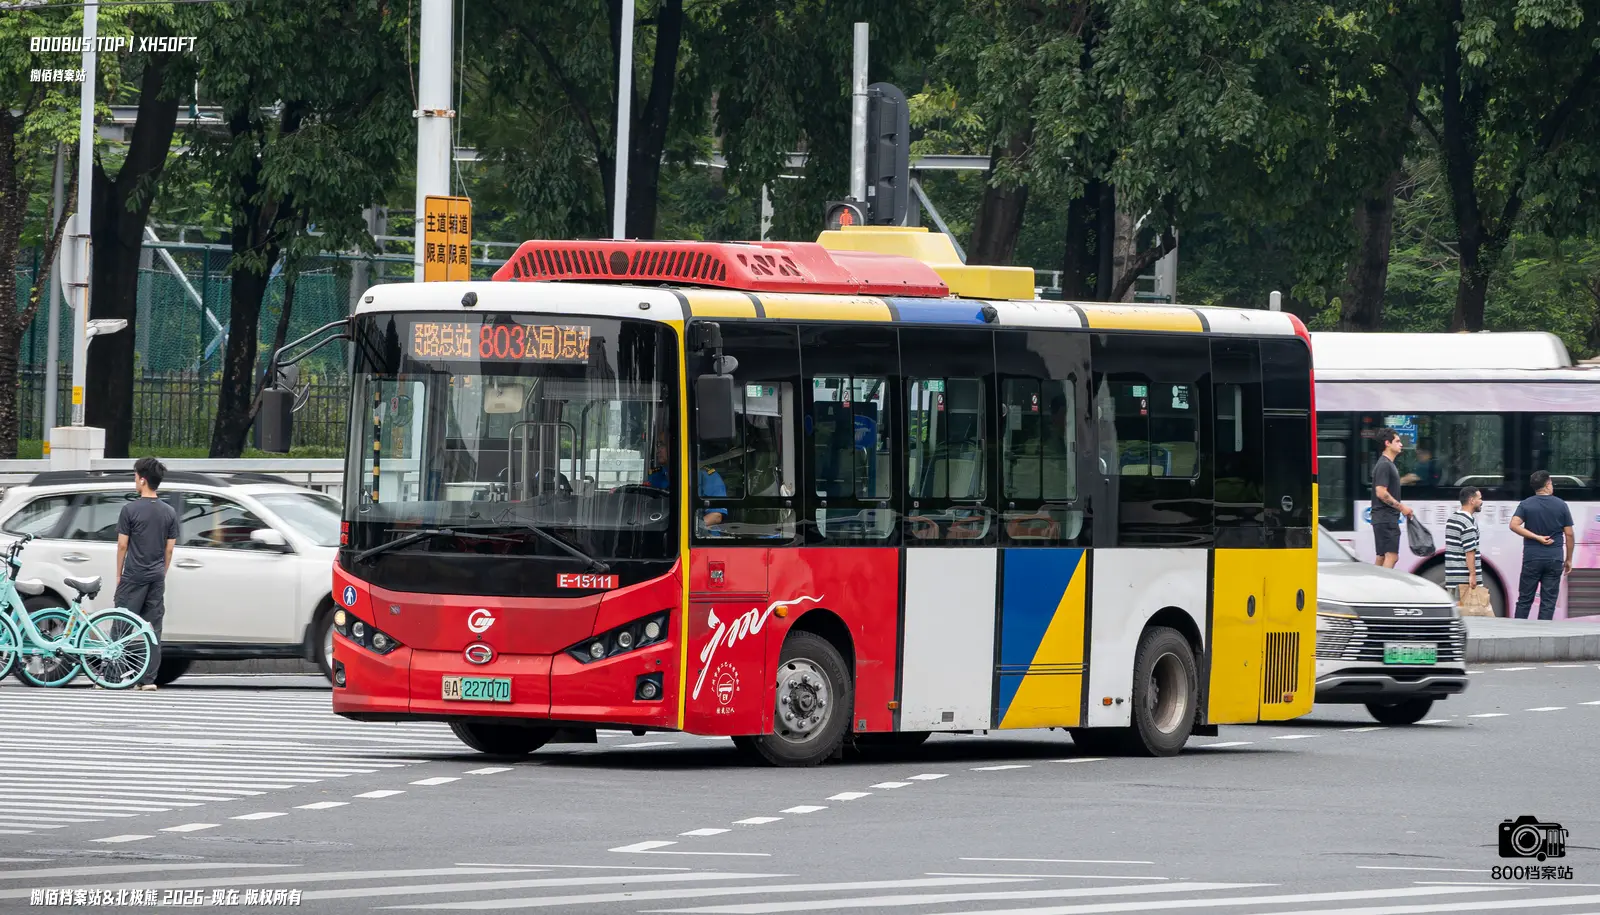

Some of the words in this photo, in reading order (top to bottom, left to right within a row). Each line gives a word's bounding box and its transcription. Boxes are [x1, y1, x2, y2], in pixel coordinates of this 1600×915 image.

[427, 212, 446, 232] 主道
[449, 213, 468, 234] 辅道
[427, 243, 446, 263] 限高
[449, 244, 468, 265] 限高
[478, 325, 525, 359] 803
[560, 575, 611, 588] E-15111
